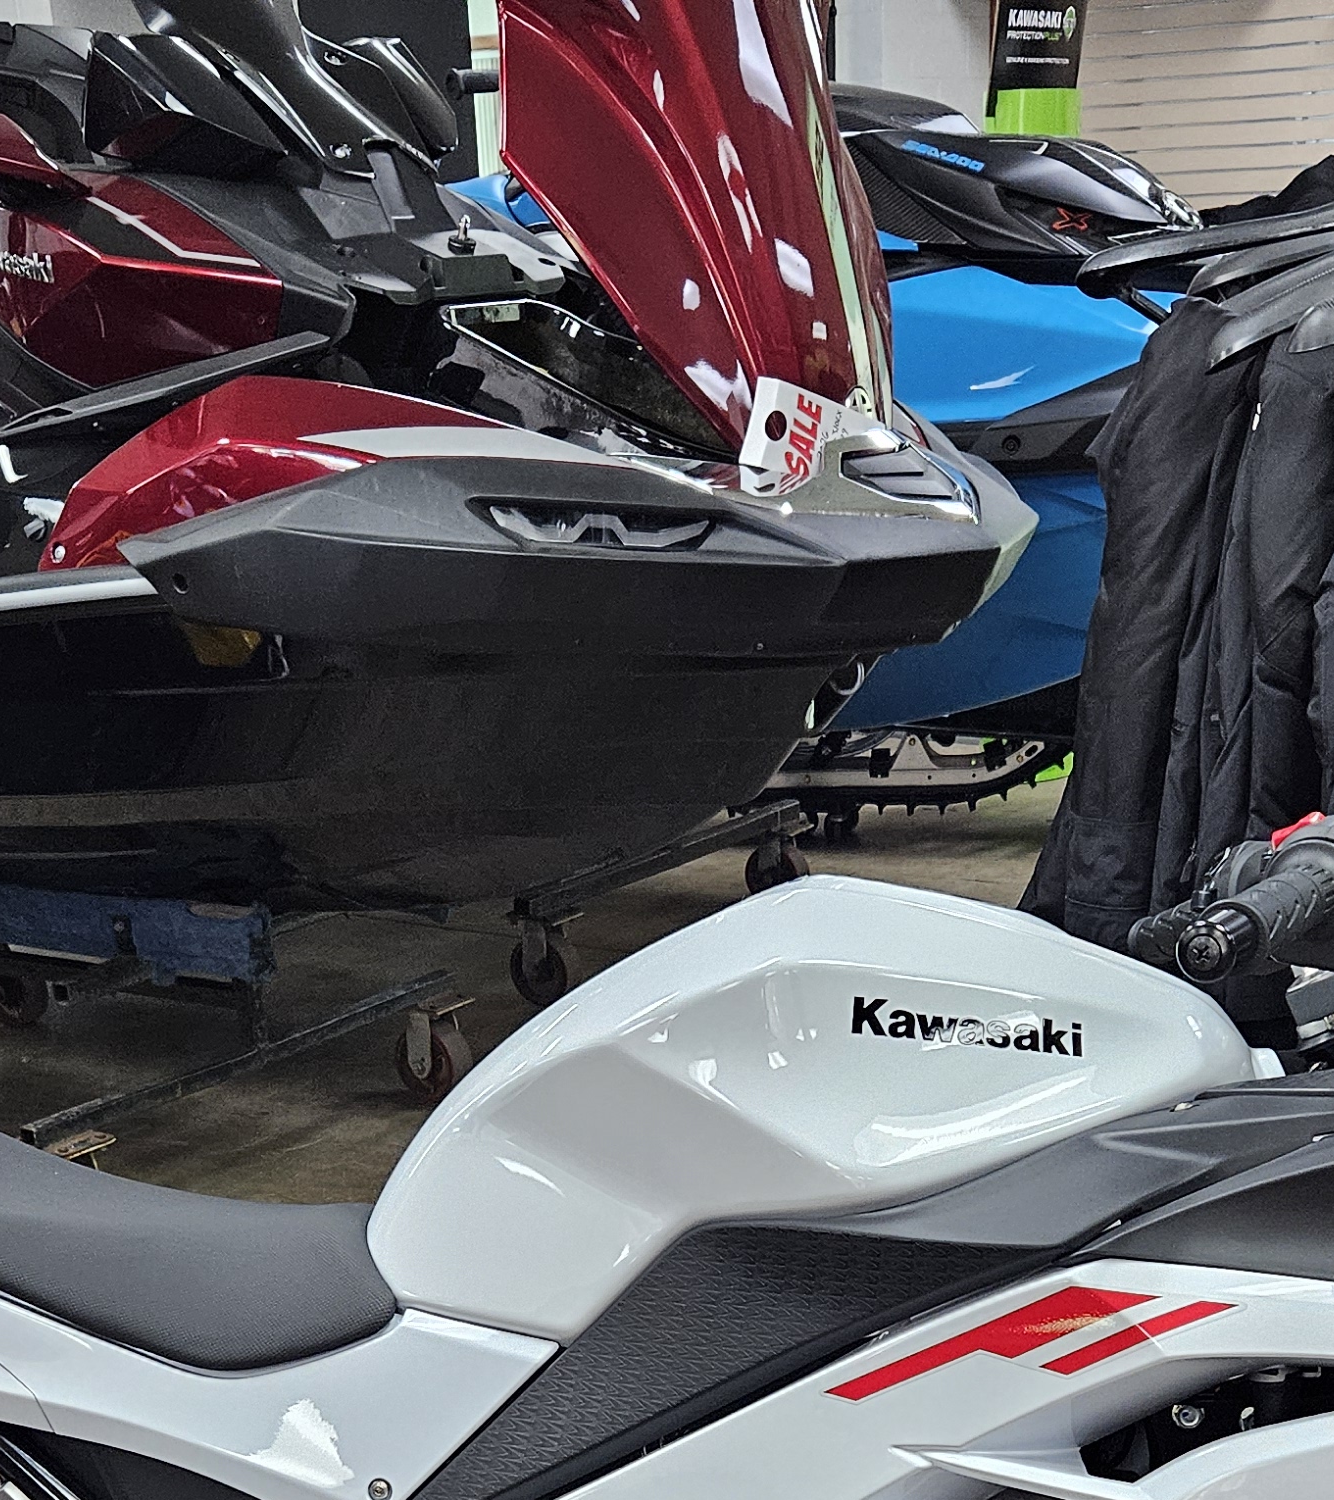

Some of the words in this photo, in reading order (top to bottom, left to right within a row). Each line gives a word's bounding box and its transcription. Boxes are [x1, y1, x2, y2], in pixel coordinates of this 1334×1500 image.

[1008, 9, 1062, 28] KAWASAKI
[784, 393, 823, 479] SALE
[851, 996, 1083, 1057] Kawasaki
